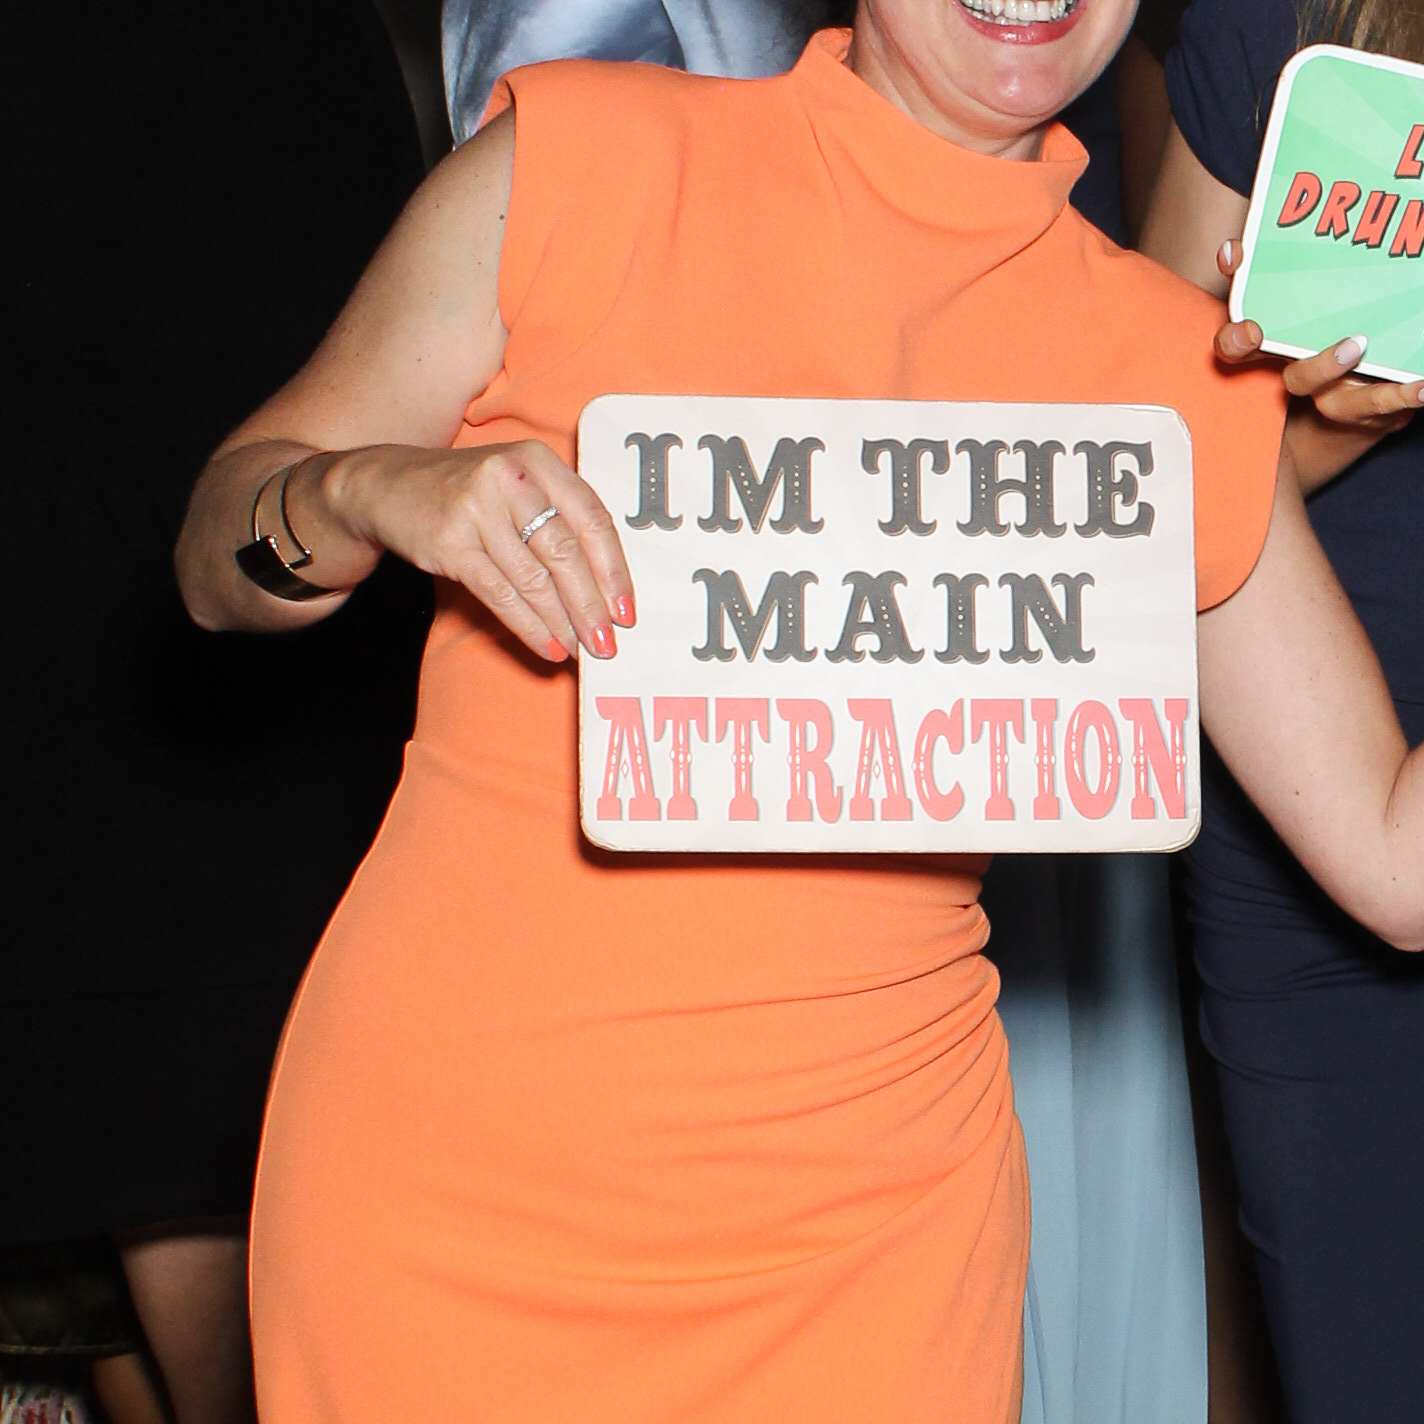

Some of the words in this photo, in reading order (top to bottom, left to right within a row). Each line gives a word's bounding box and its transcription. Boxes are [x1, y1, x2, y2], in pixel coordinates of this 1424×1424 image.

[624, 431, 825, 535] IM
[861, 437, 1155, 538] THE
[692, 568, 1096, 665] MAIN
[595, 696, 1191, 825] ATTRACTION
